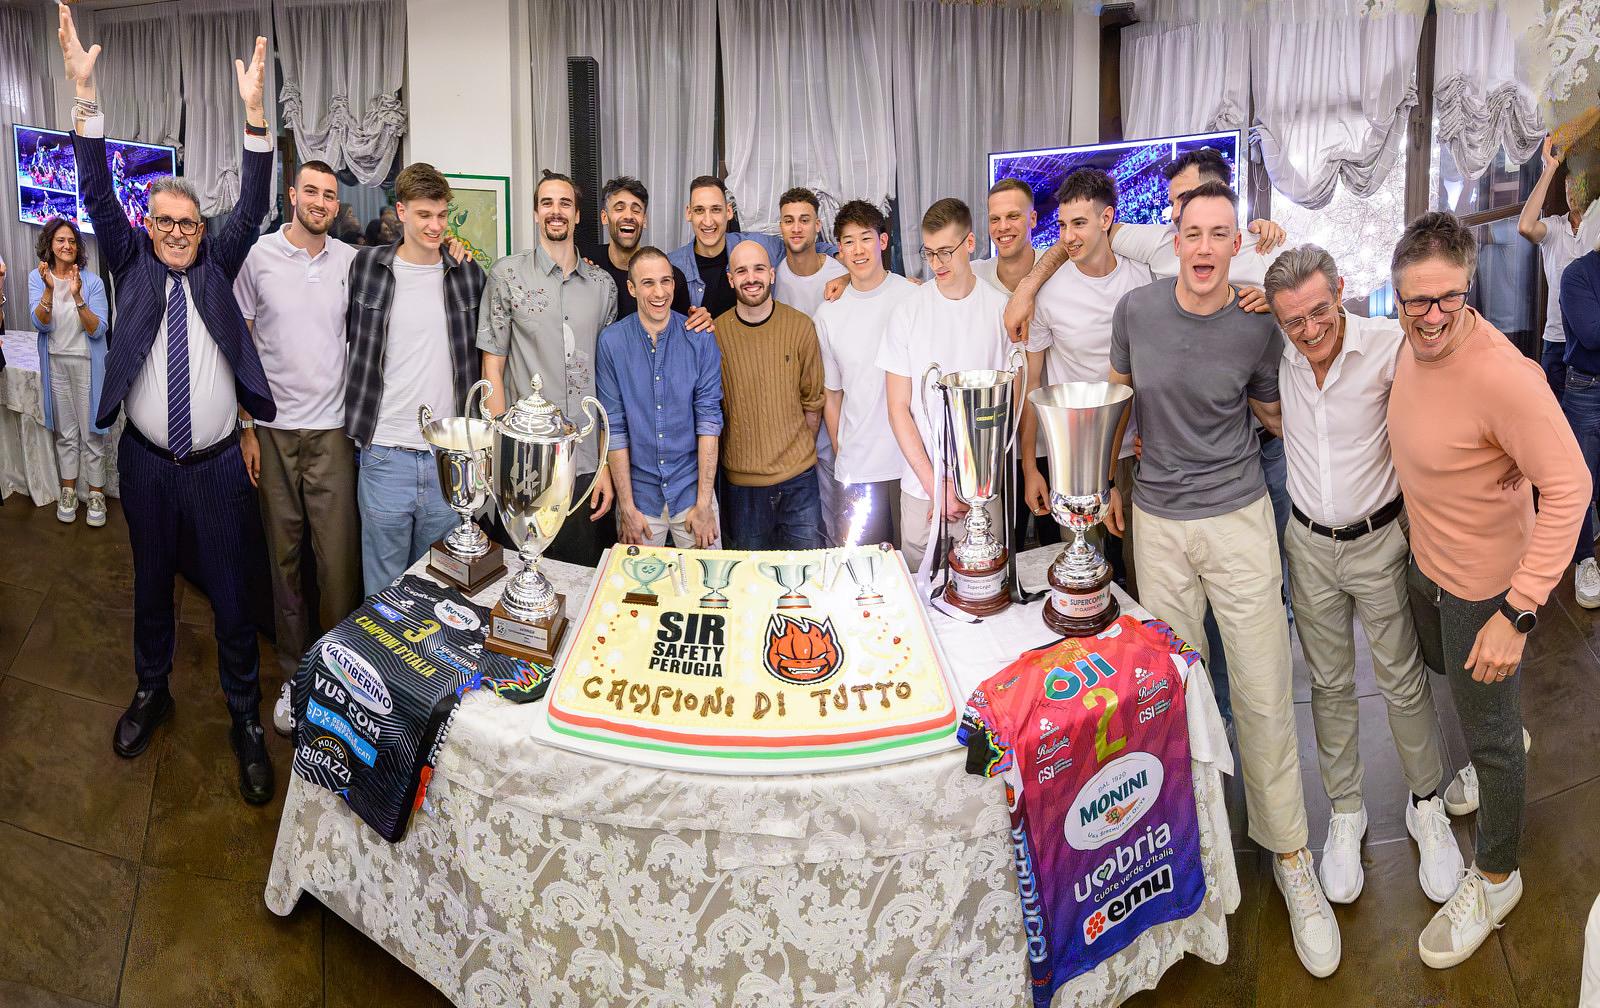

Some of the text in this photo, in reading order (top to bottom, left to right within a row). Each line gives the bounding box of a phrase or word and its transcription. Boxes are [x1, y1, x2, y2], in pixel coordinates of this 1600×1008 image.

[355, 616, 401, 649] CAMPIONI
[393, 646, 436, 678] D'ITALIA
[403, 619, 441, 642] 3
[657, 611, 725, 645] SIR
[649, 657, 722, 677] PERUGIA
[653, 641, 724, 662] SAFETY
[326, 643, 391, 709] VALTIBERINO
[1044, 652, 1117, 701] OJI
[315, 672, 346, 704] VUS
[348, 702, 380, 739] COM
[753, 691, 786, 720] DI
[810, 680, 912, 717] TUTTO
[1139, 705, 1155, 723] CSI
[1083, 687, 1128, 764] 2
[301, 746, 352, 783] BIGAZZI
[318, 739, 344, 759] MOLINO
[1038, 765, 1055, 784] CSI
[1098, 781, 1110, 793] DAL
[1079, 769, 1148, 827] MONINI
[1011, 817, 1047, 963] VERDUCCI
[1094, 848, 1174, 903] Cuore verde d'Italia
[1107, 868, 1171, 922] emu
